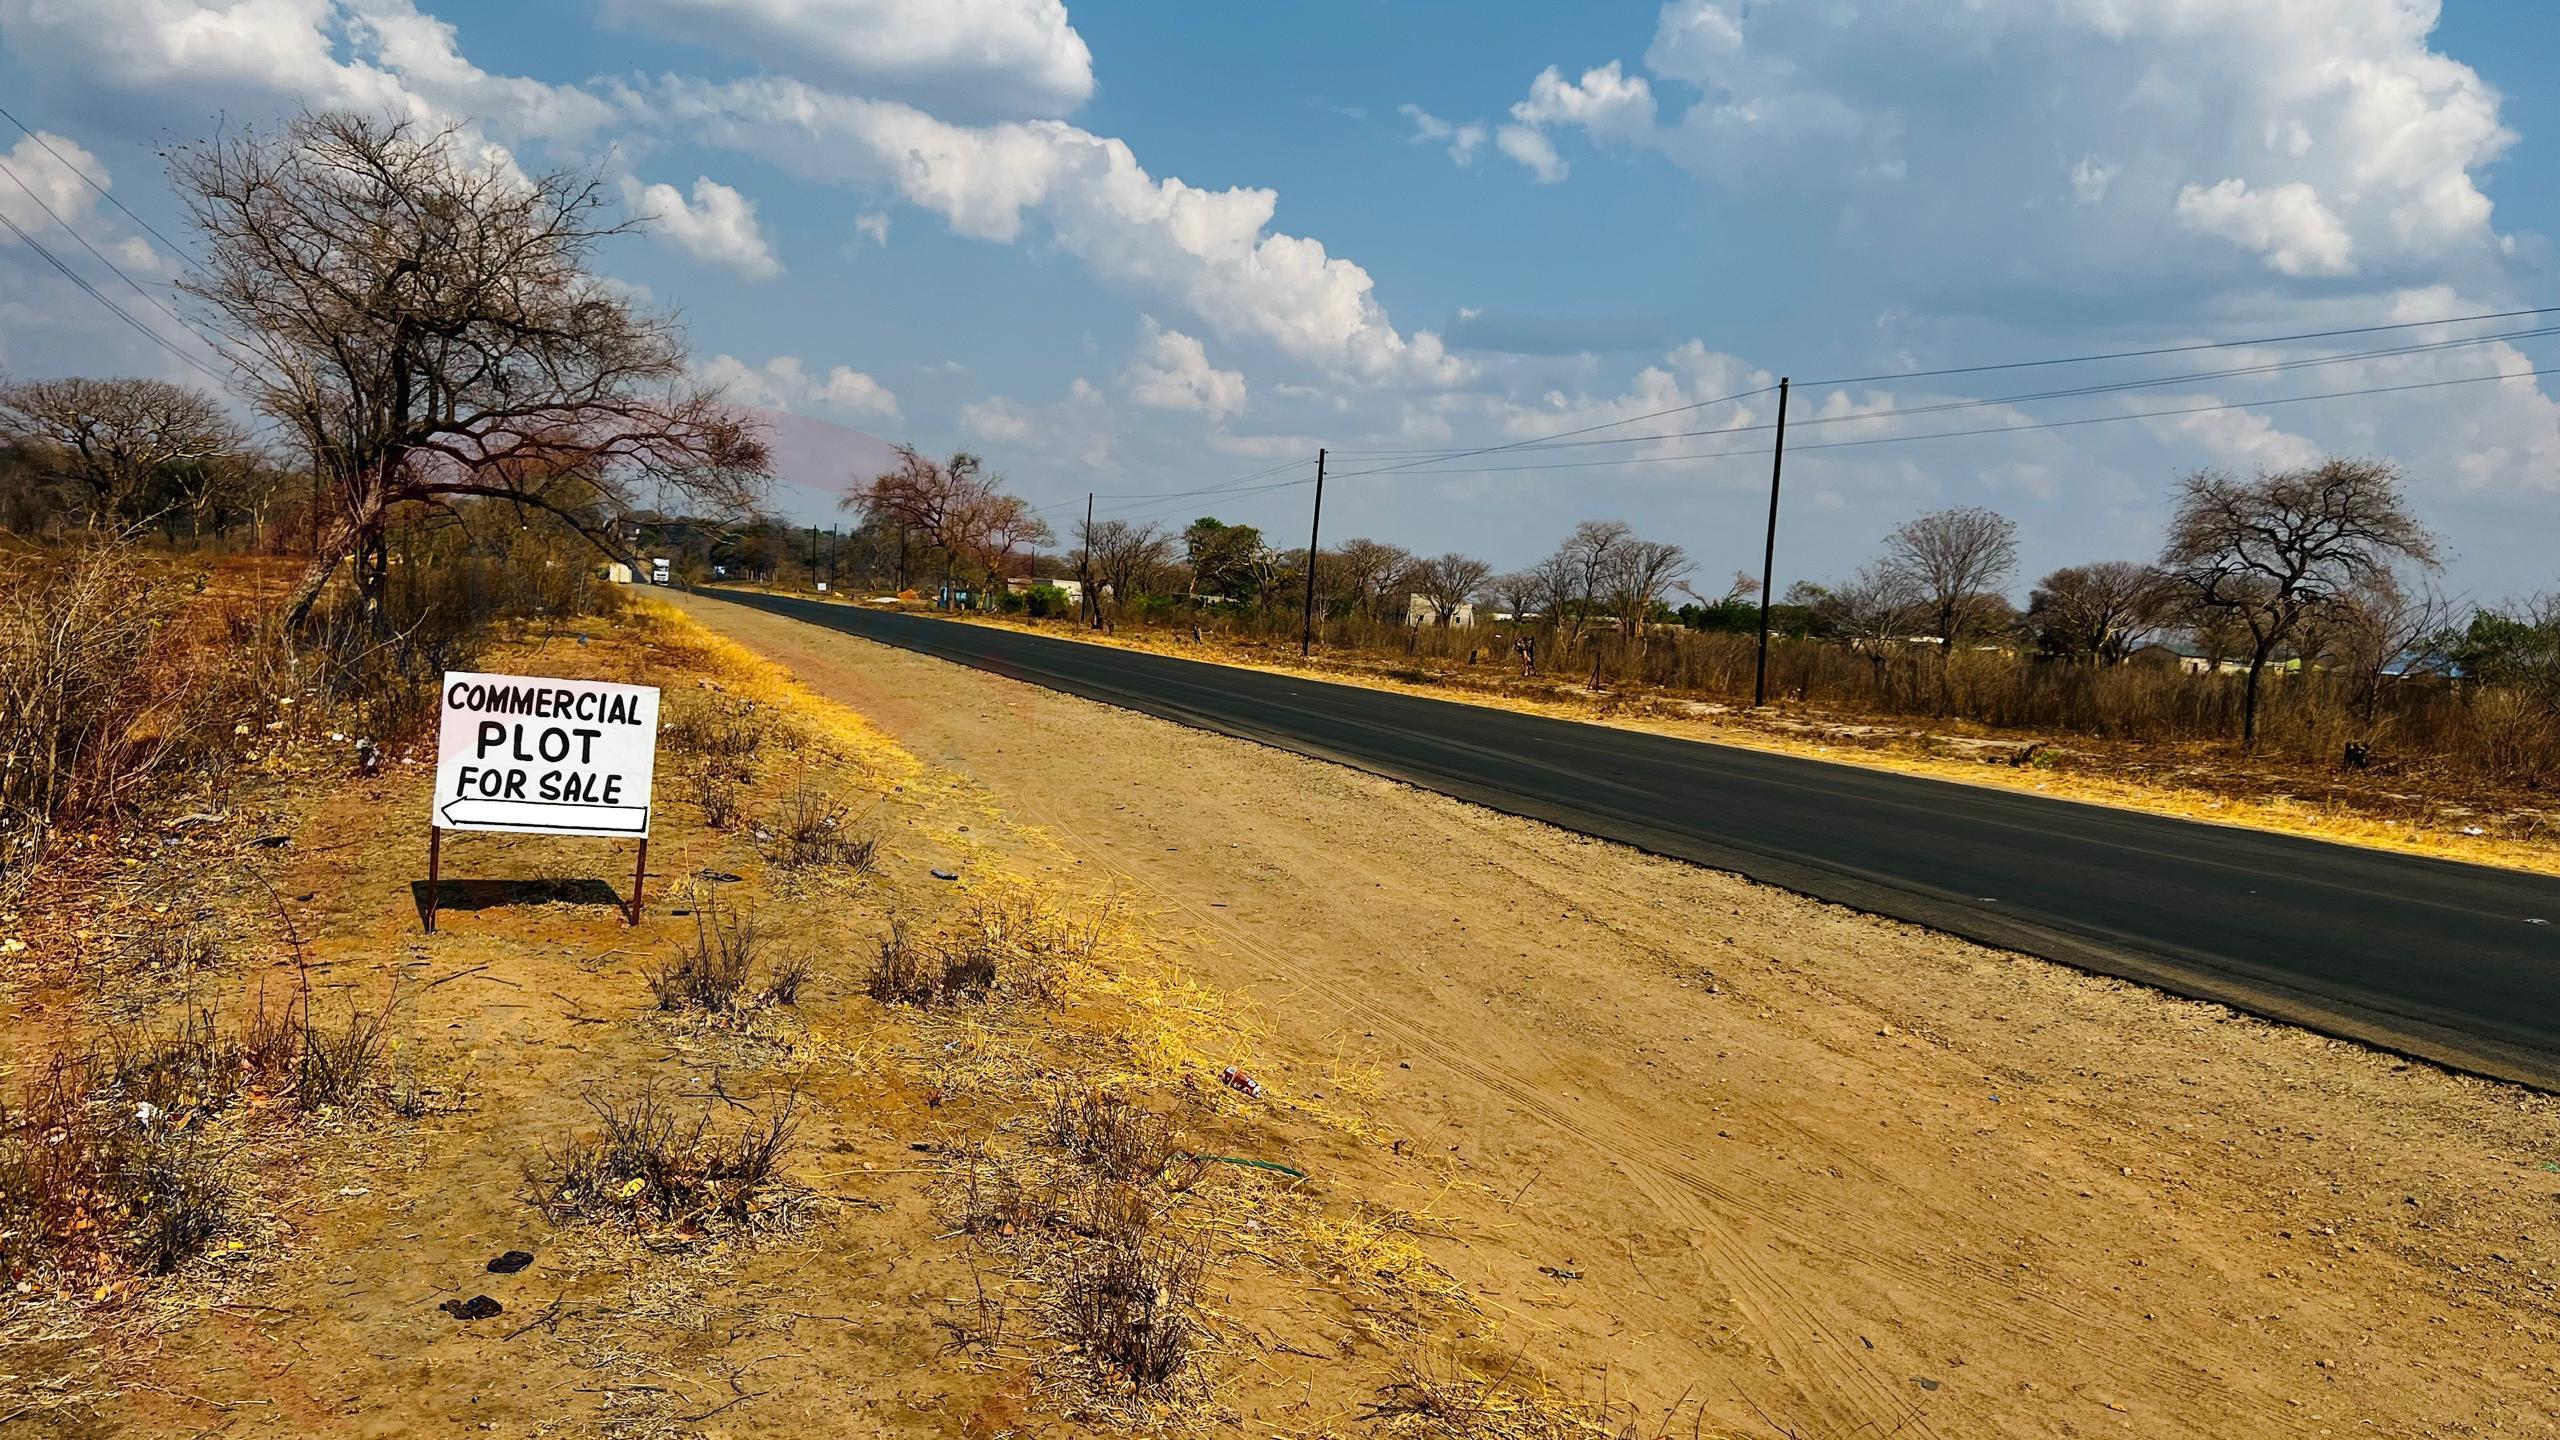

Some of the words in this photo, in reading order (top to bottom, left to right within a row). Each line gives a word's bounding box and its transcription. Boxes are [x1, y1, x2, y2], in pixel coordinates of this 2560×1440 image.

[447, 681, 642, 725] COMMERCIAL
[477, 721, 601, 764] PLOT
[456, 766, 527, 799] FOR
[539, 770, 622, 804] SALE
